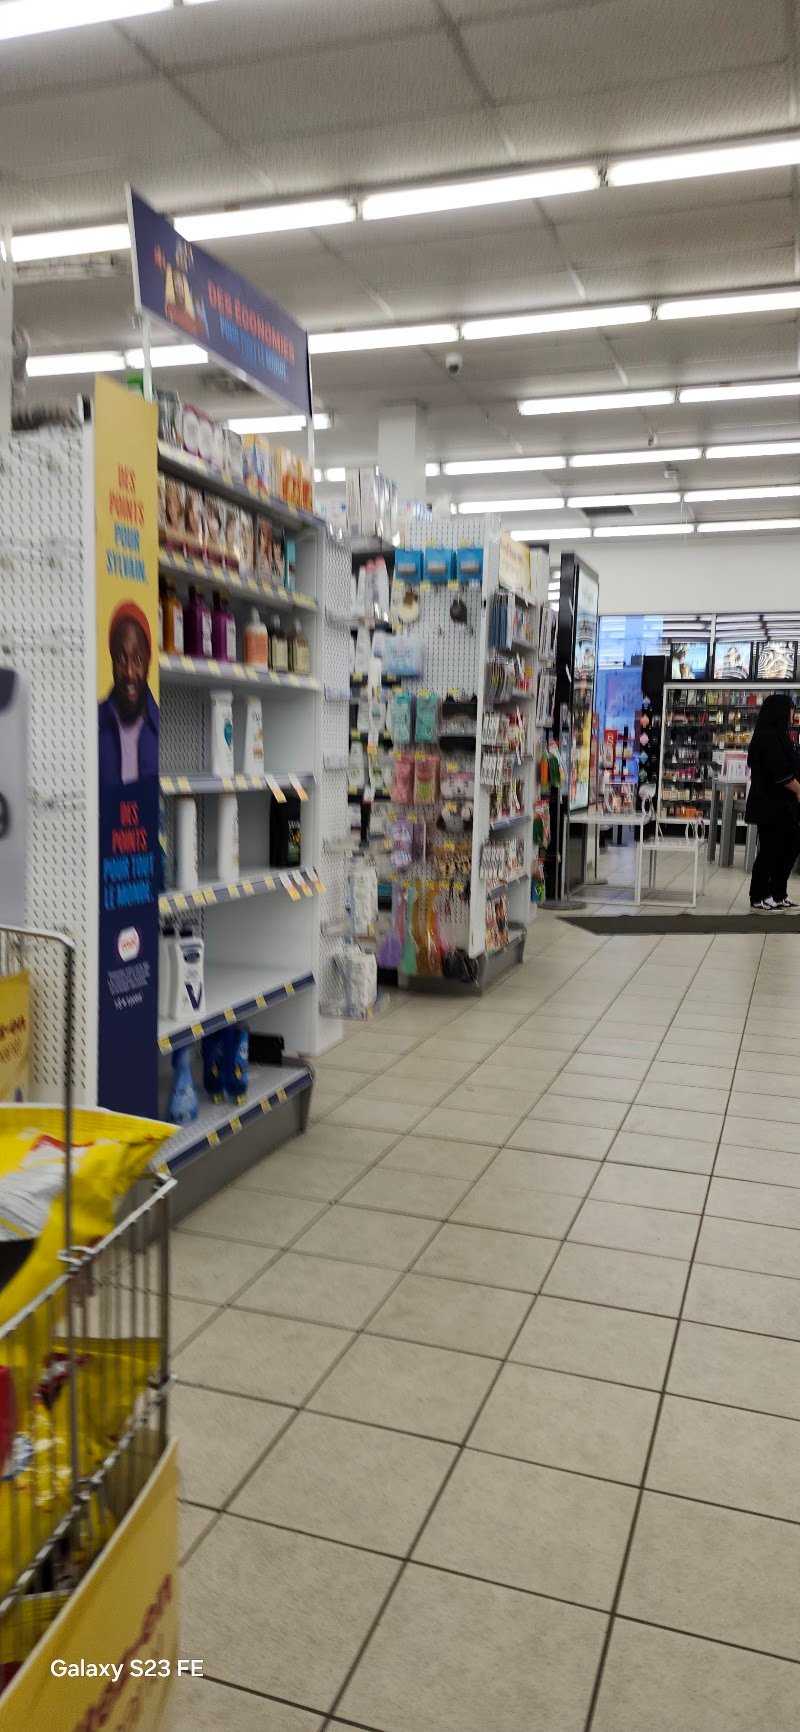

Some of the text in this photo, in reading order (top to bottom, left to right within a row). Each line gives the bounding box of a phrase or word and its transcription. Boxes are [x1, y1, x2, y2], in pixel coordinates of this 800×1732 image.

[118, 464, 136, 495] DES
[109, 490, 144, 527] POINTS
[114, 521, 140, 553] POUR
[120, 801, 139, 825] DES
[112, 828, 147, 855] POINTS
[103, 852, 154, 881] POUR TOUT
[104, 883, 115, 911] LE
